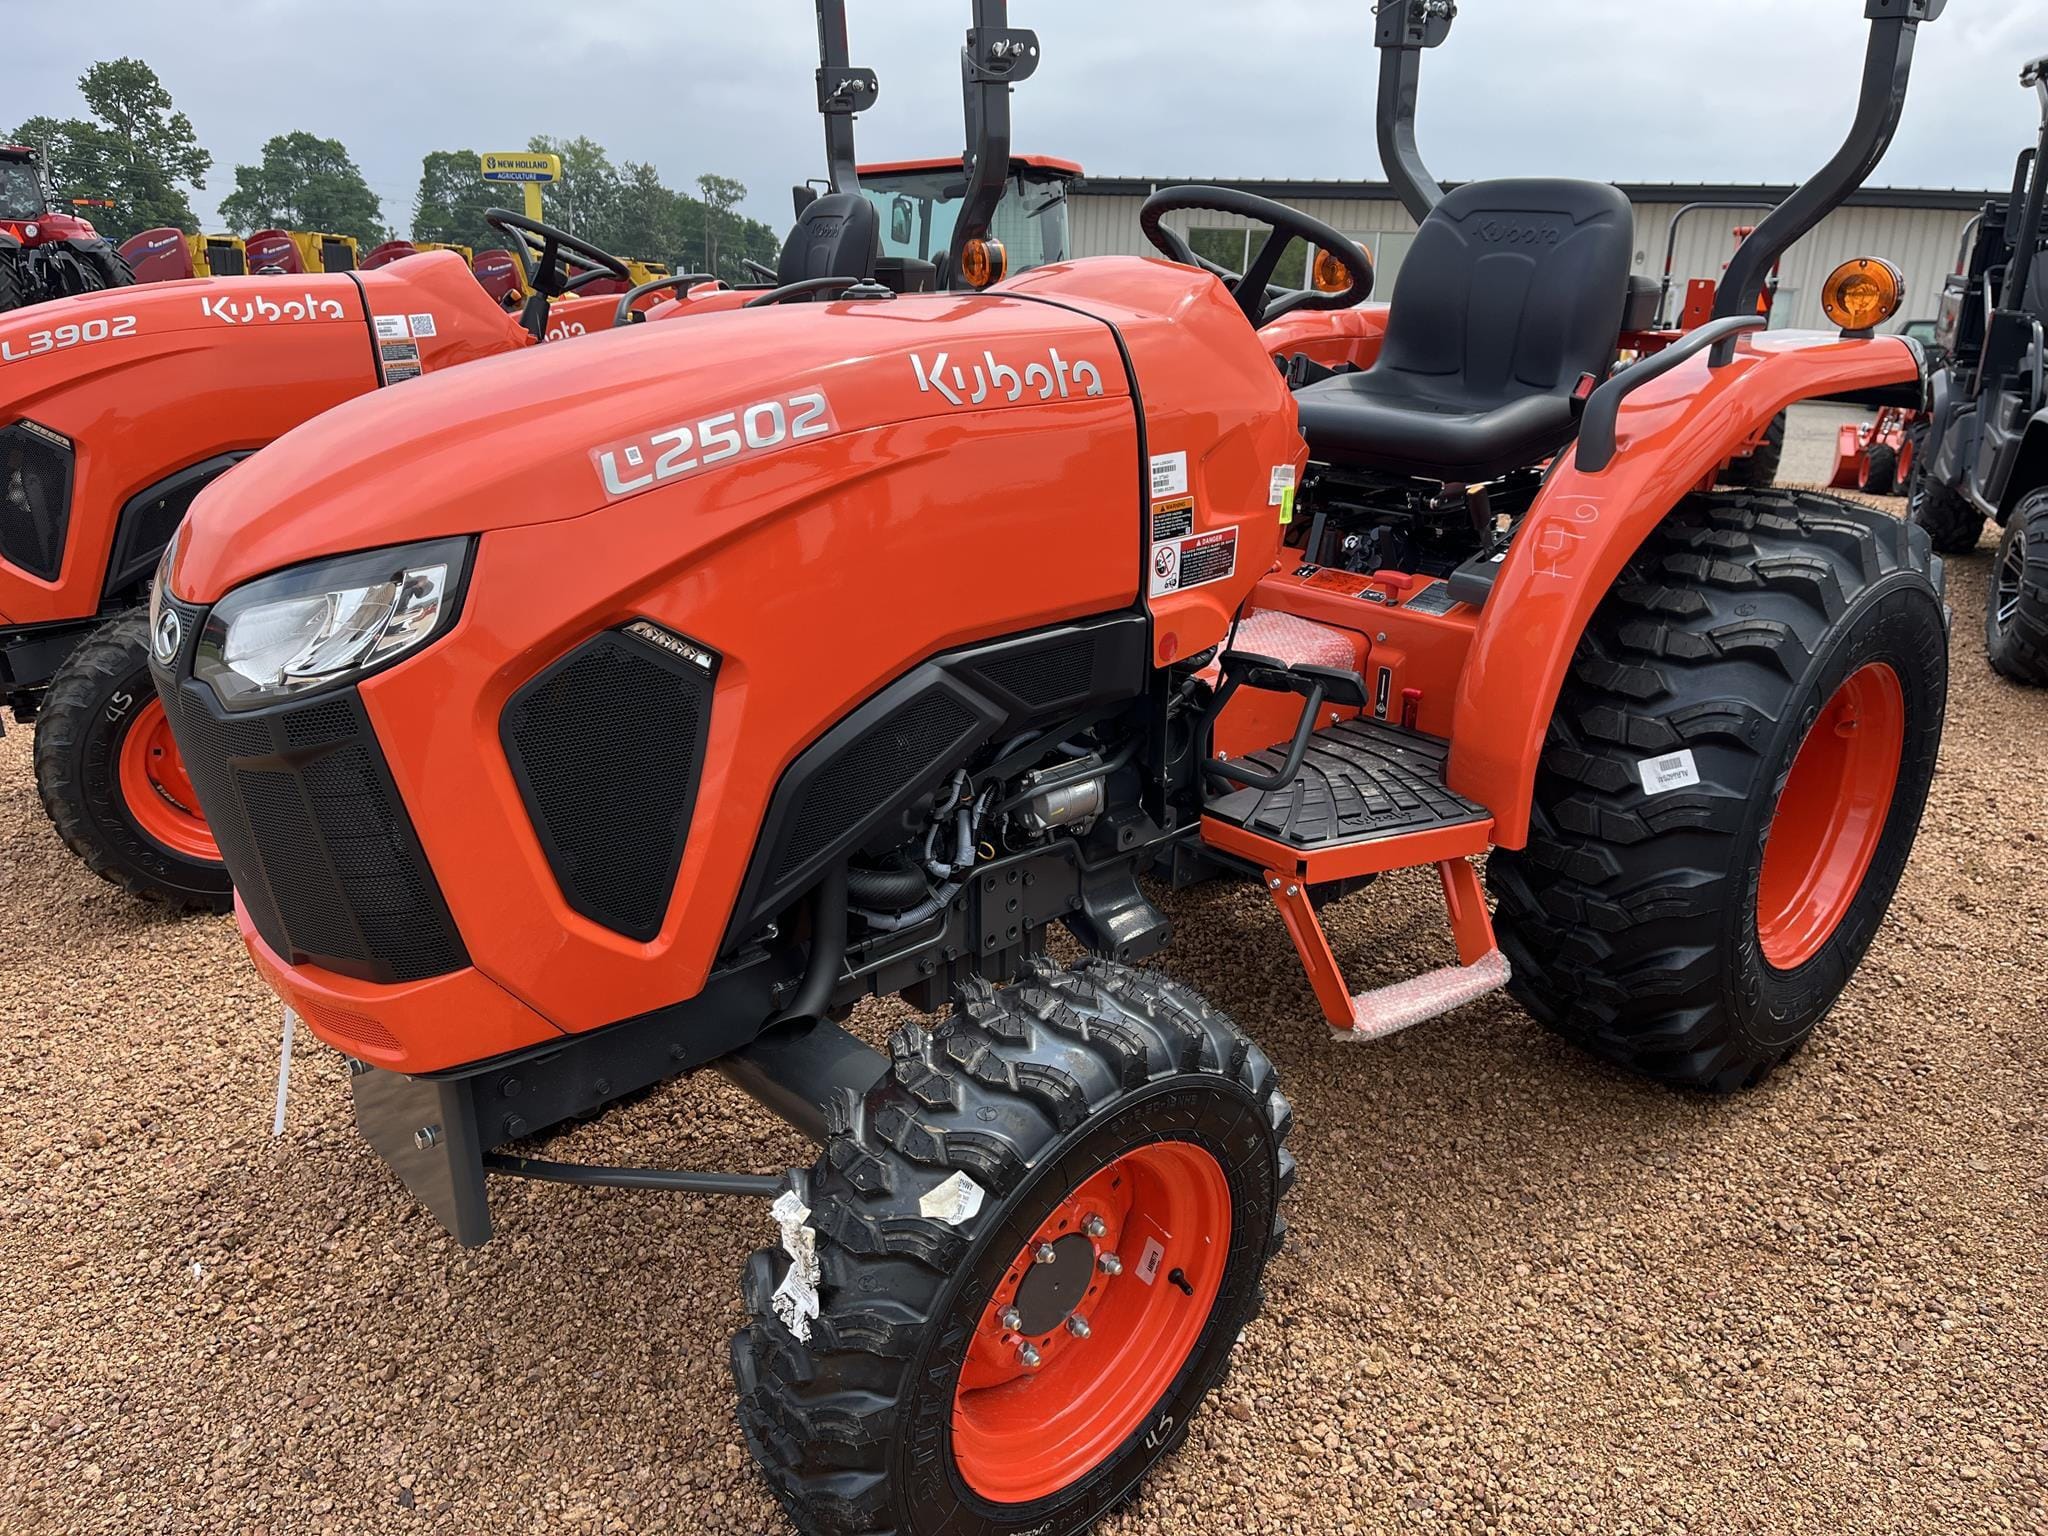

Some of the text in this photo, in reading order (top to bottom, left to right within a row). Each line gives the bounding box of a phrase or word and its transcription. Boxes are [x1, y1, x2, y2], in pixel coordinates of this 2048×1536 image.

[498, 160, 548, 169] NEW HOLLAND
[498, 172, 537, 180] AGRICULTURE
[1472, 219, 1560, 244] Kubota
[201, 293, 345, 324] Kubota
[1, 315, 137, 362] L3902
[909, 348, 1104, 405] Kubota
[600, 393, 829, 495] L2502
[1202, 534, 1223, 545] DANGER
[105, 690, 133, 723] 45
